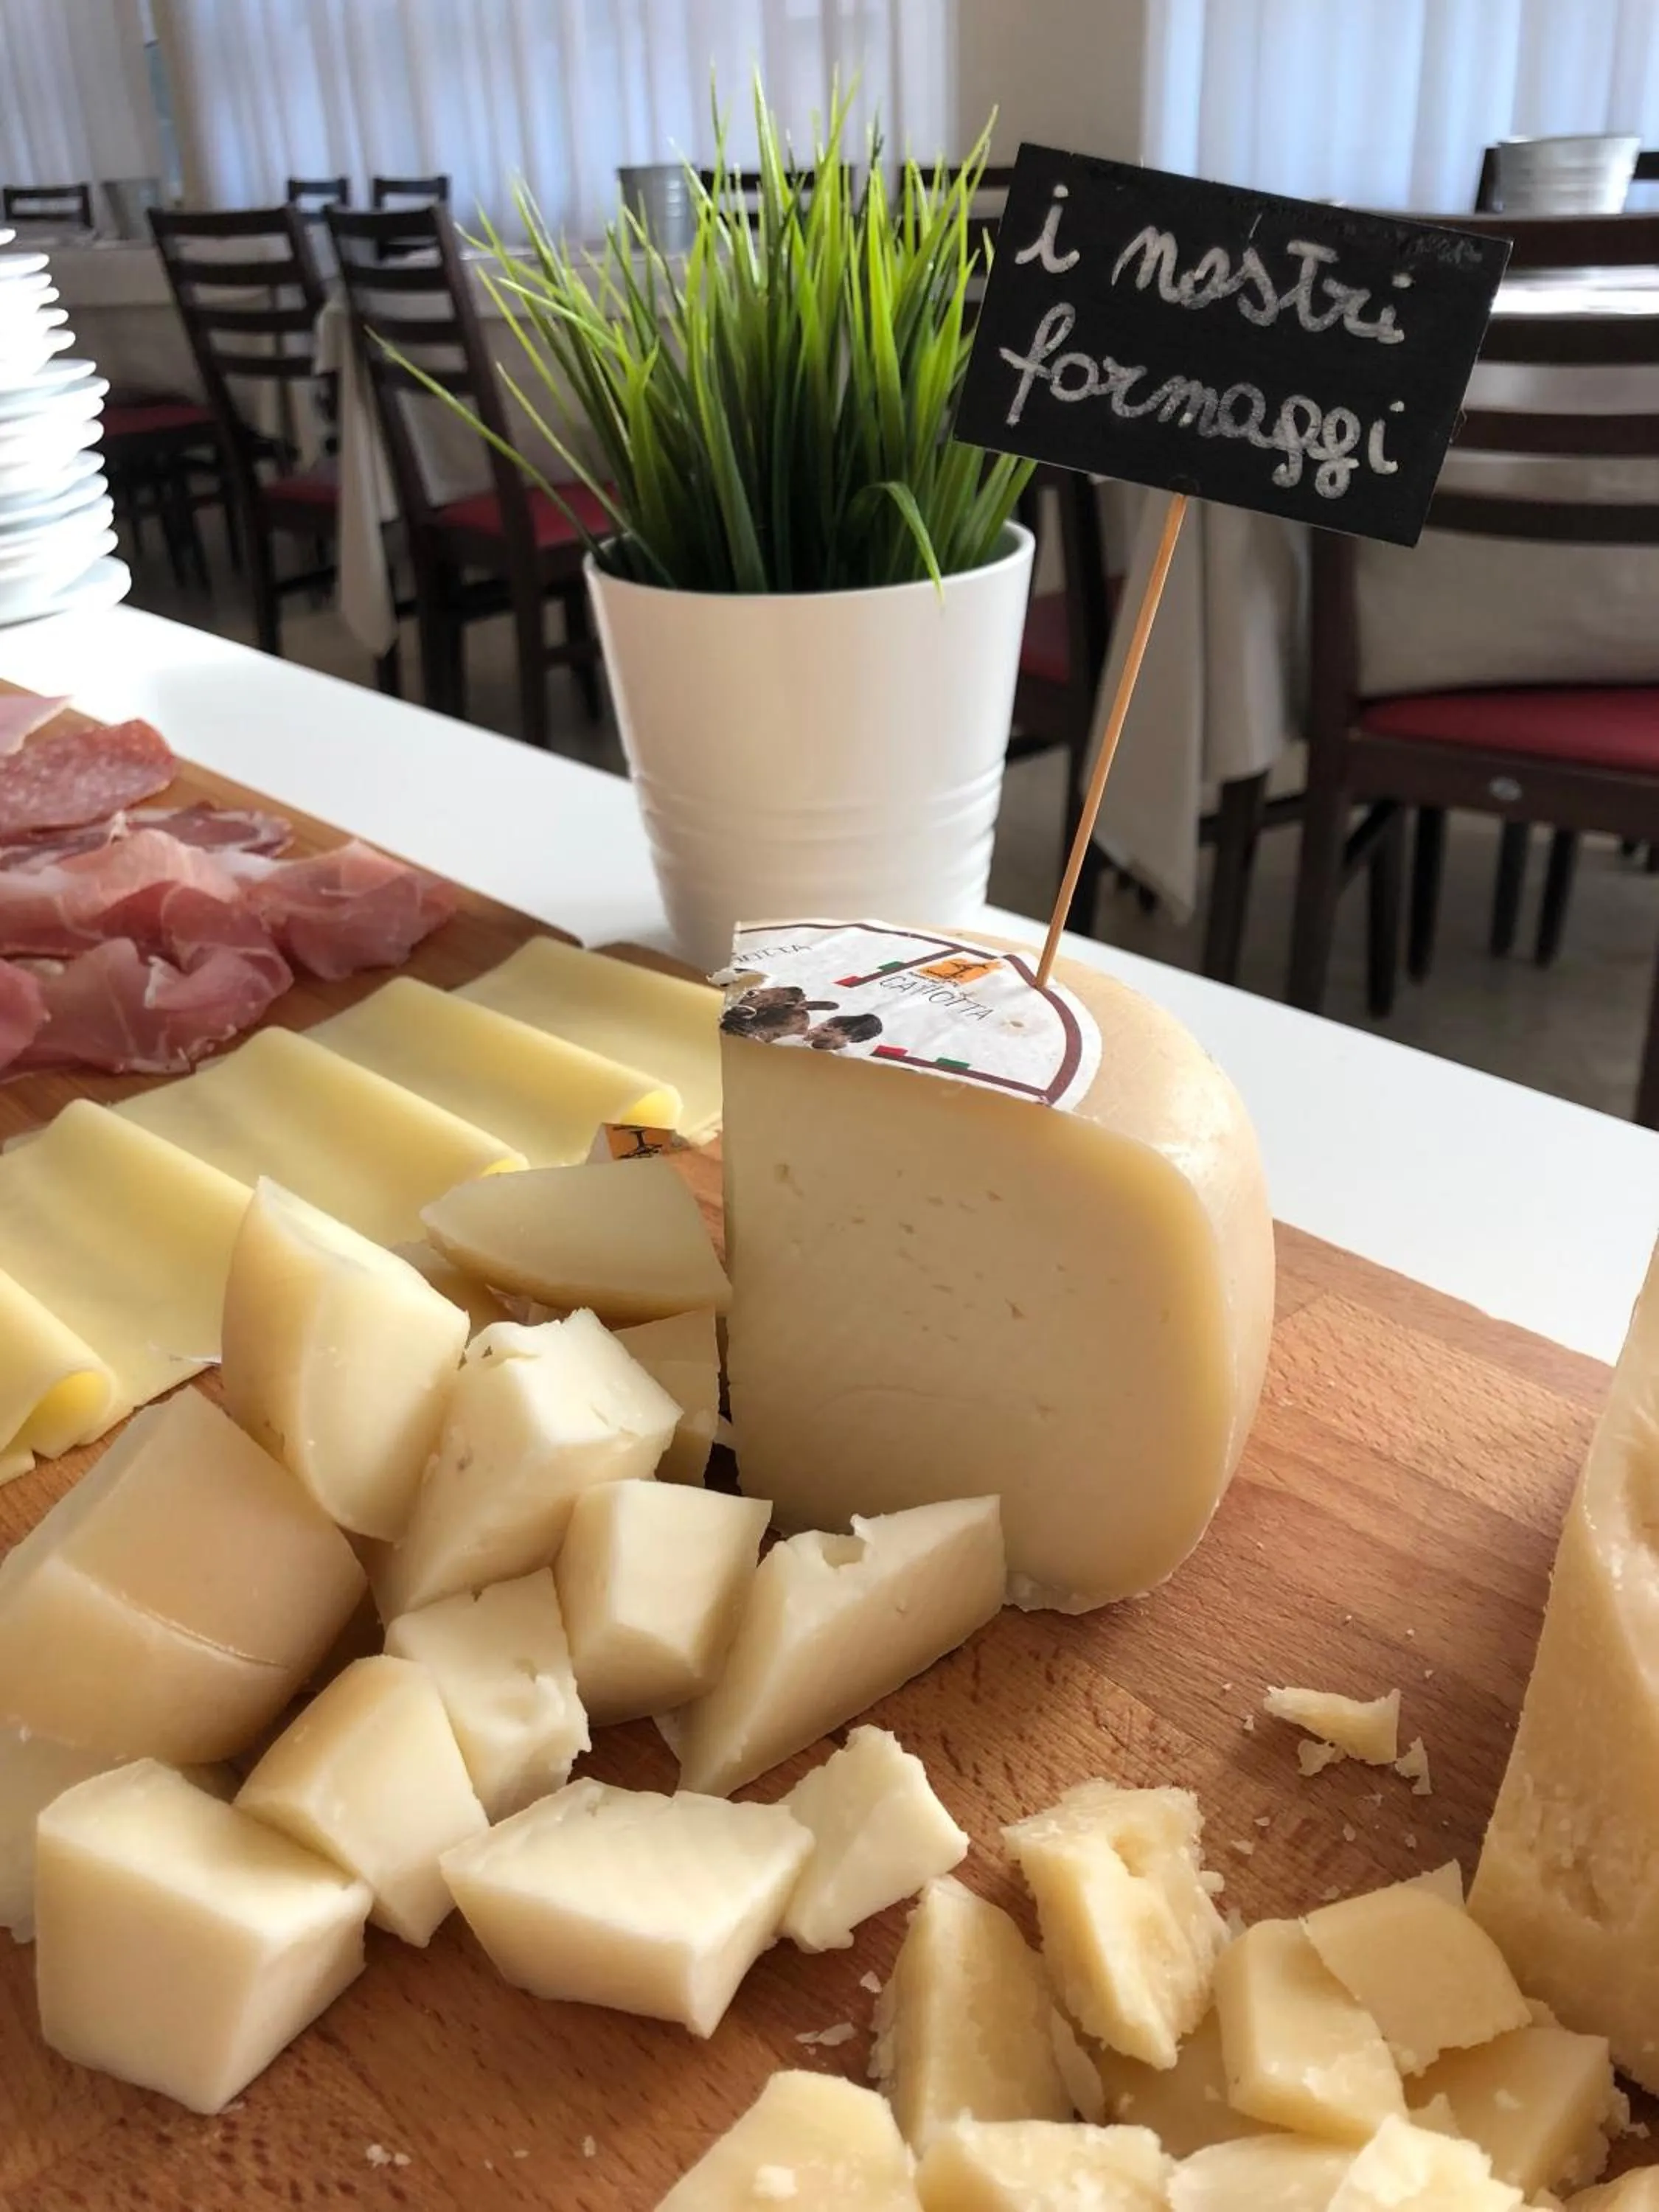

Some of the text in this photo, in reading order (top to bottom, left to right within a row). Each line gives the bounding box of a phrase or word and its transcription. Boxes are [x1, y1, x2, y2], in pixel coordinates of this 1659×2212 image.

[1015, 184, 1413, 345] i nostri
[999, 302, 1405, 499] formaggi
